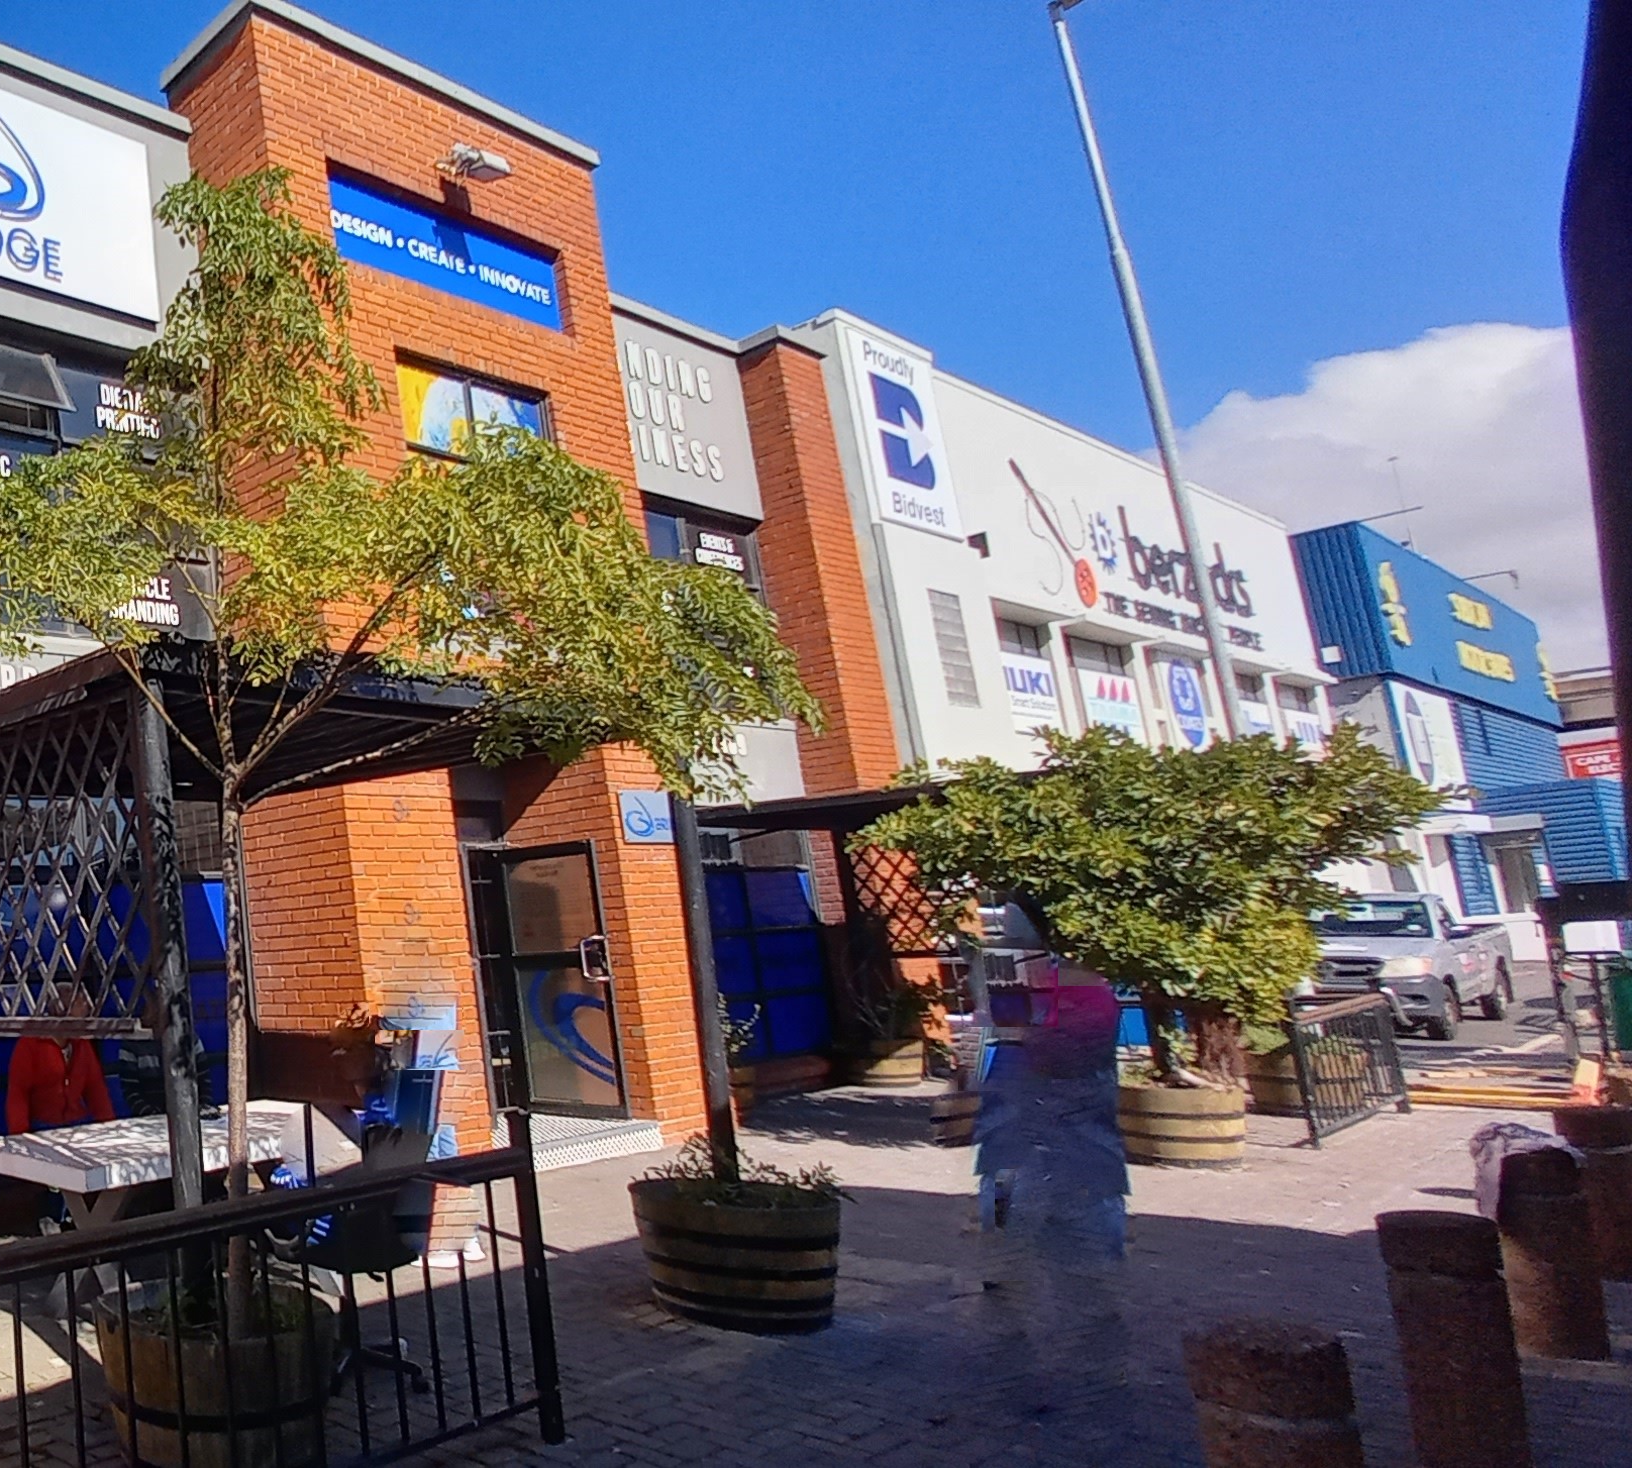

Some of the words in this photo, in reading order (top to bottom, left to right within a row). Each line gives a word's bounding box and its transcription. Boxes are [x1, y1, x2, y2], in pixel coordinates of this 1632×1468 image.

[329, 208, 394, 249] DESIGN
[478, 264, 552, 306] INNOVATE
[625, 339, 713, 404] NDING
[862, 340, 916, 387] Proudly
[628, 381, 686, 432] OUR
[637, 424, 725, 482] INESS
[891, 490, 948, 528] Bidvest
[108, 598, 181, 627] BRANDING
[1587, 762, 1622, 776] ELEC
